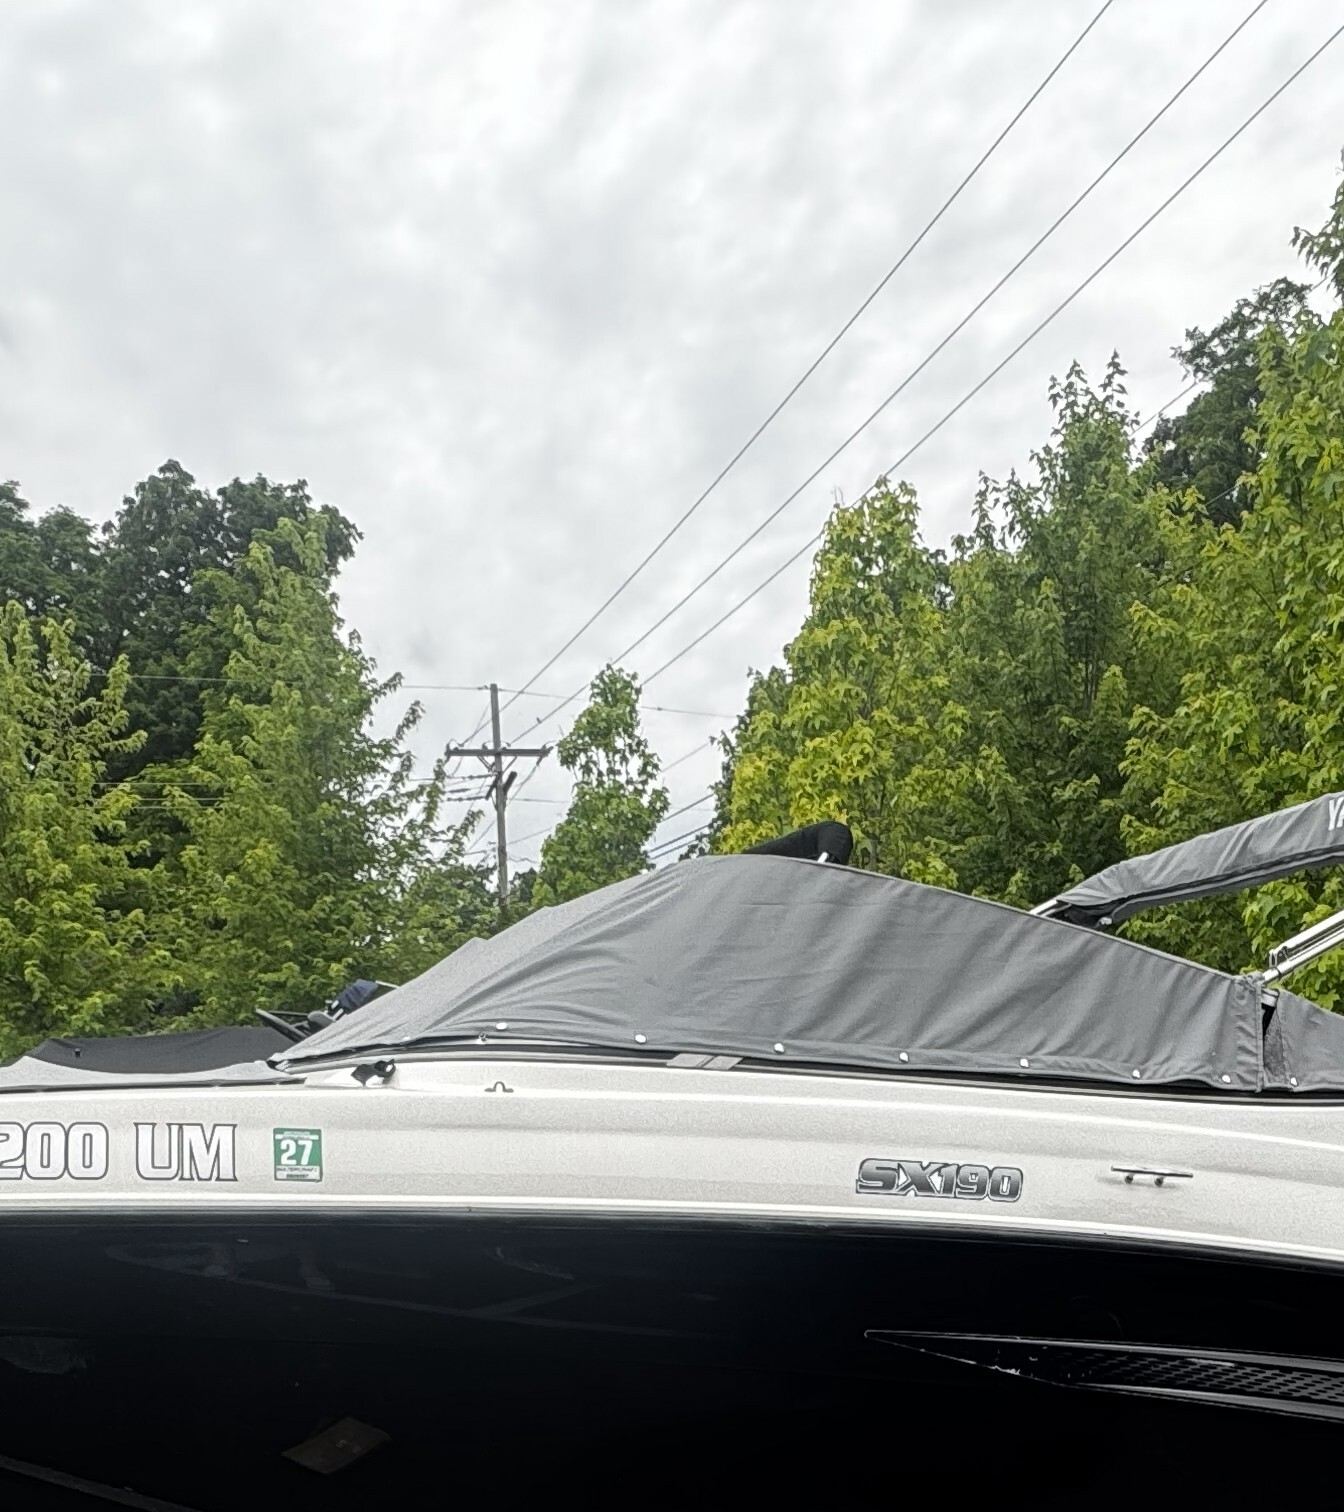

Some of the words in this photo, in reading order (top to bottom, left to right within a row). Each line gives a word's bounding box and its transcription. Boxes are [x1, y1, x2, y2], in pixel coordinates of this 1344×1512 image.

[133, 1122, 239, 1183] UM
[280, 1138, 313, 1166] 27
[856, 1158, 1024, 1203] SX190
